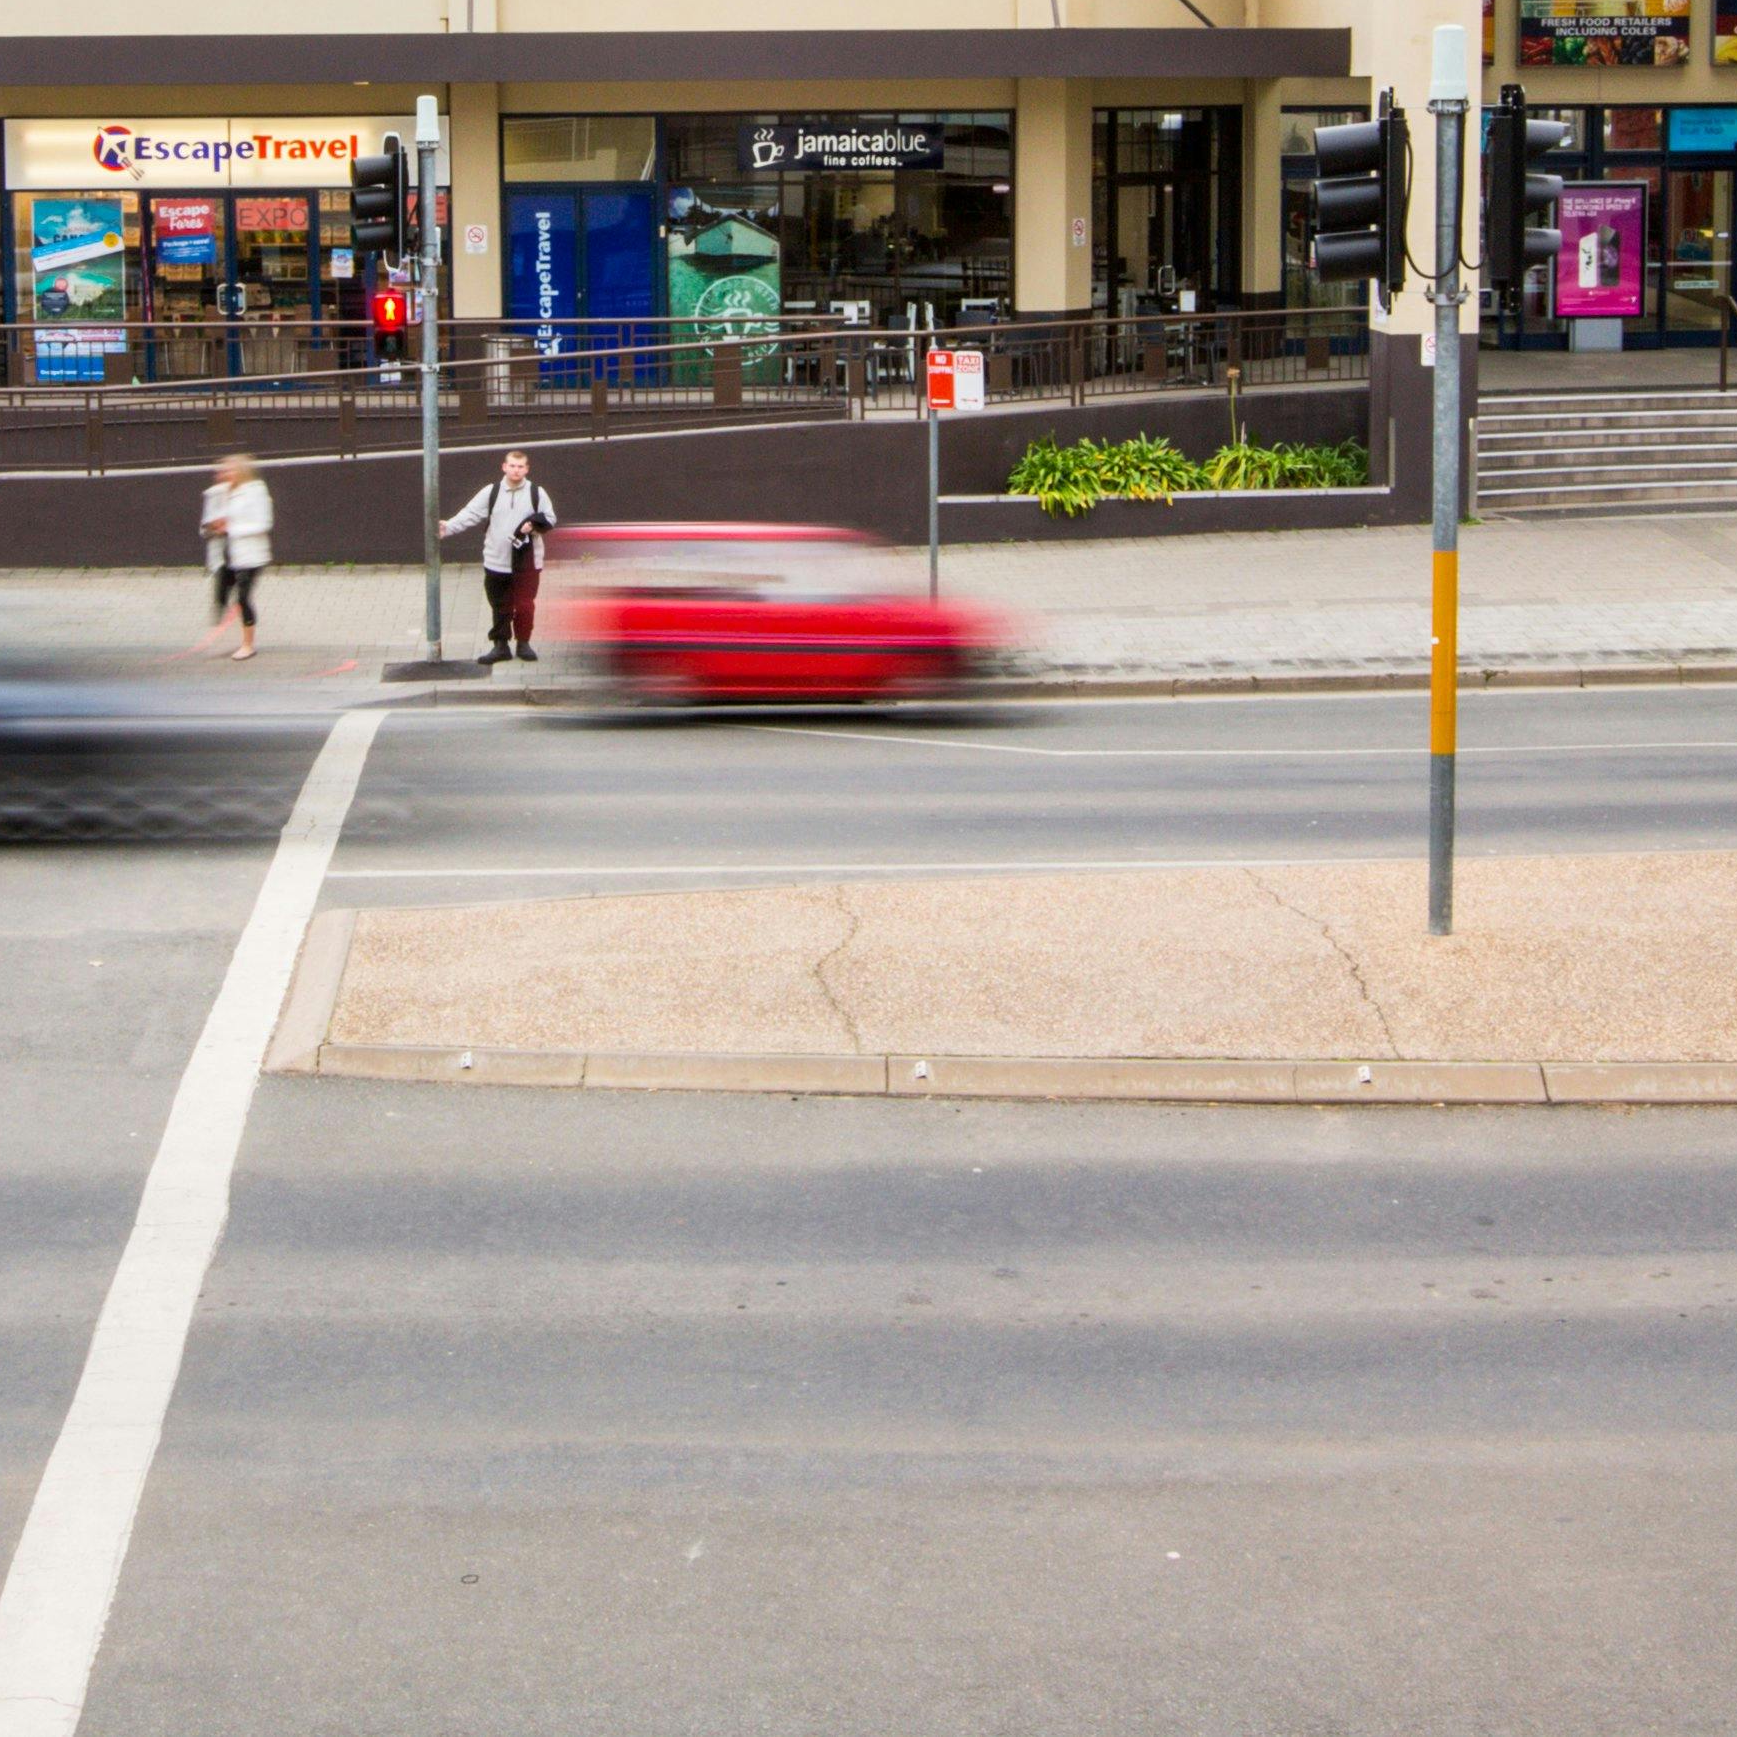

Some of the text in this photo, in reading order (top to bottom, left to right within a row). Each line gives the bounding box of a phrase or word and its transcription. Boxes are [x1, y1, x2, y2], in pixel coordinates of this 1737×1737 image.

[1541, 18, 1671, 26] FRESH FOOD RETAILERS
[1555, 27, 1657, 36] INCLUDING COLES
[794, 128, 927, 159] jamaicablue
[134, 135, 358, 172] EscapeTravel
[823, 155, 897, 166] fine coffees
[159, 205, 210, 218] Escape
[239, 207, 307, 227] EXPO
[534, 212, 559, 338] EcapeTravel
[935, 354, 947, 364] NO
[957, 355, 981, 364] TAXI
[957, 364, 981, 373] ZONE
